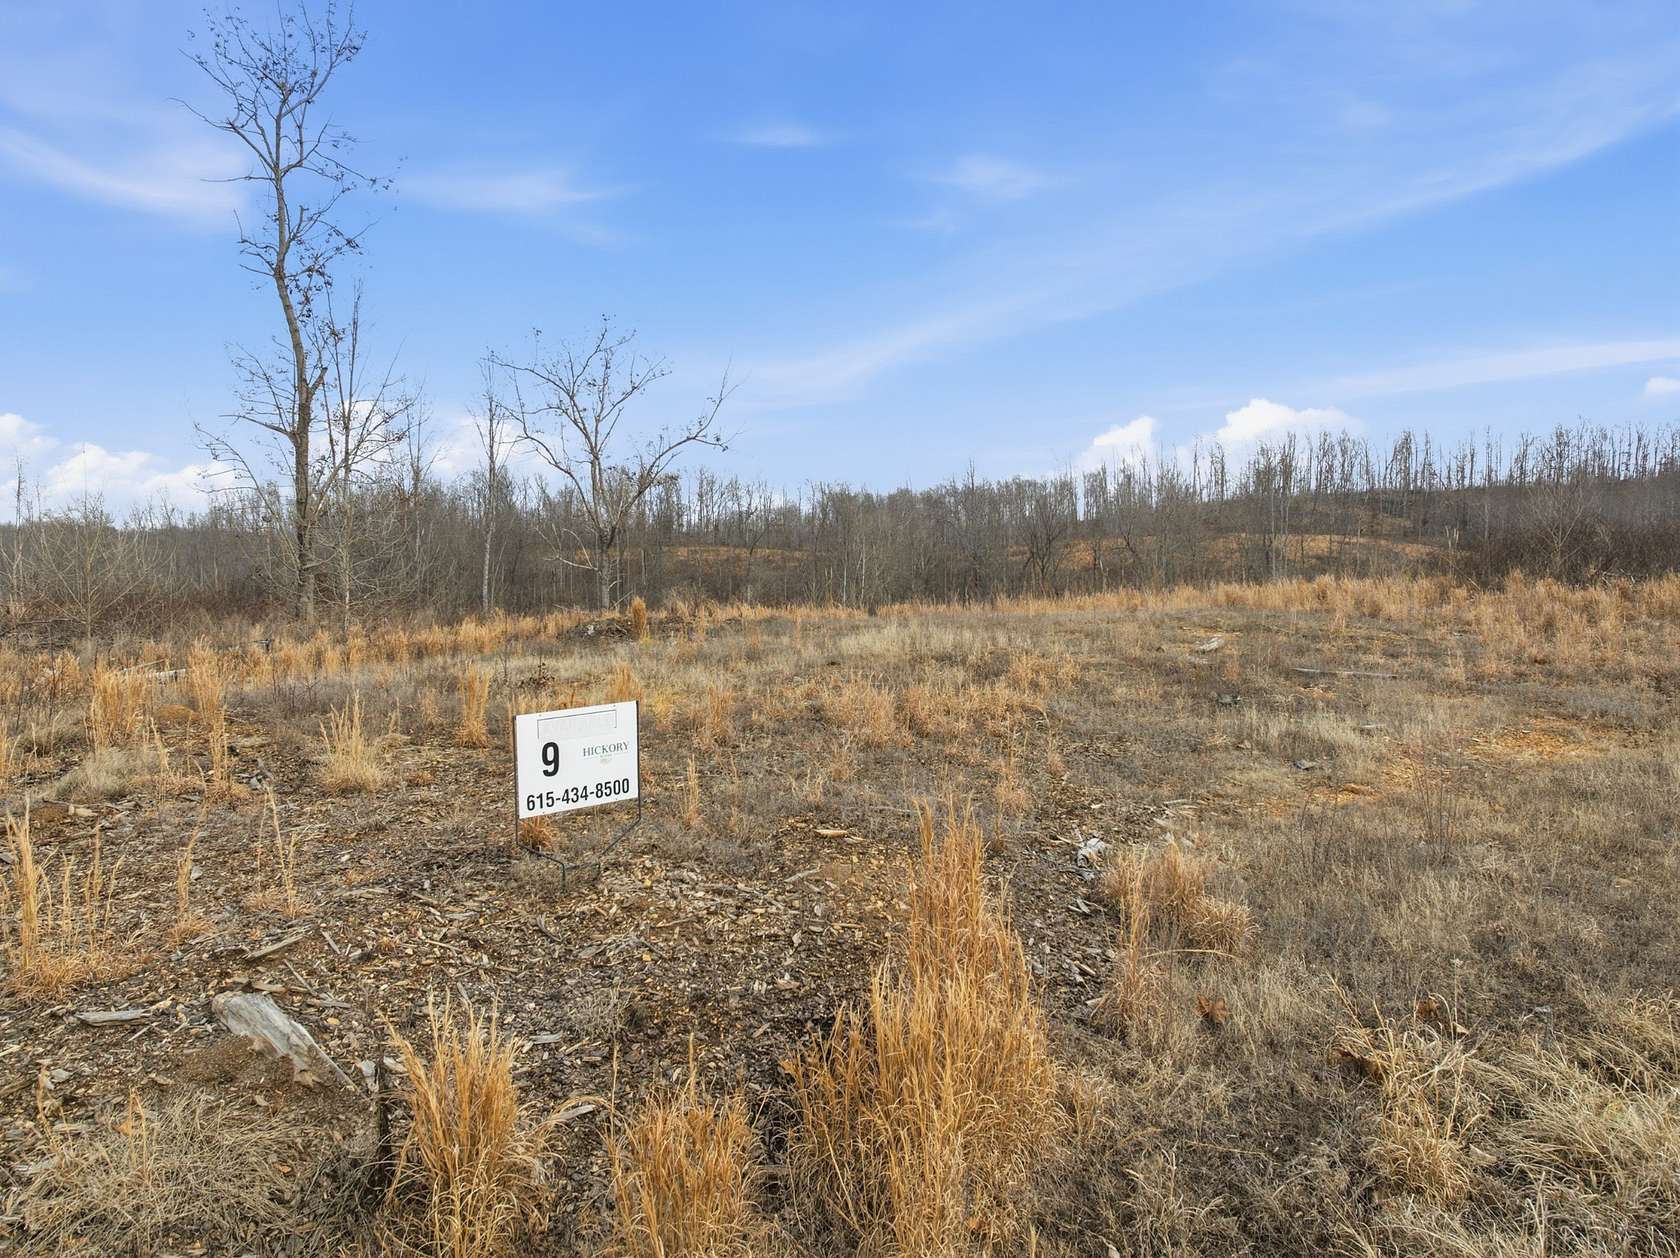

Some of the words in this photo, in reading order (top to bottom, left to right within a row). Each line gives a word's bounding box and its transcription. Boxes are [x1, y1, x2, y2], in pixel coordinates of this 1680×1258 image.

[541, 742, 560, 777] 9
[583, 741, 630, 757] HICKORY
[526, 778, 630, 811] 615-434-8500
